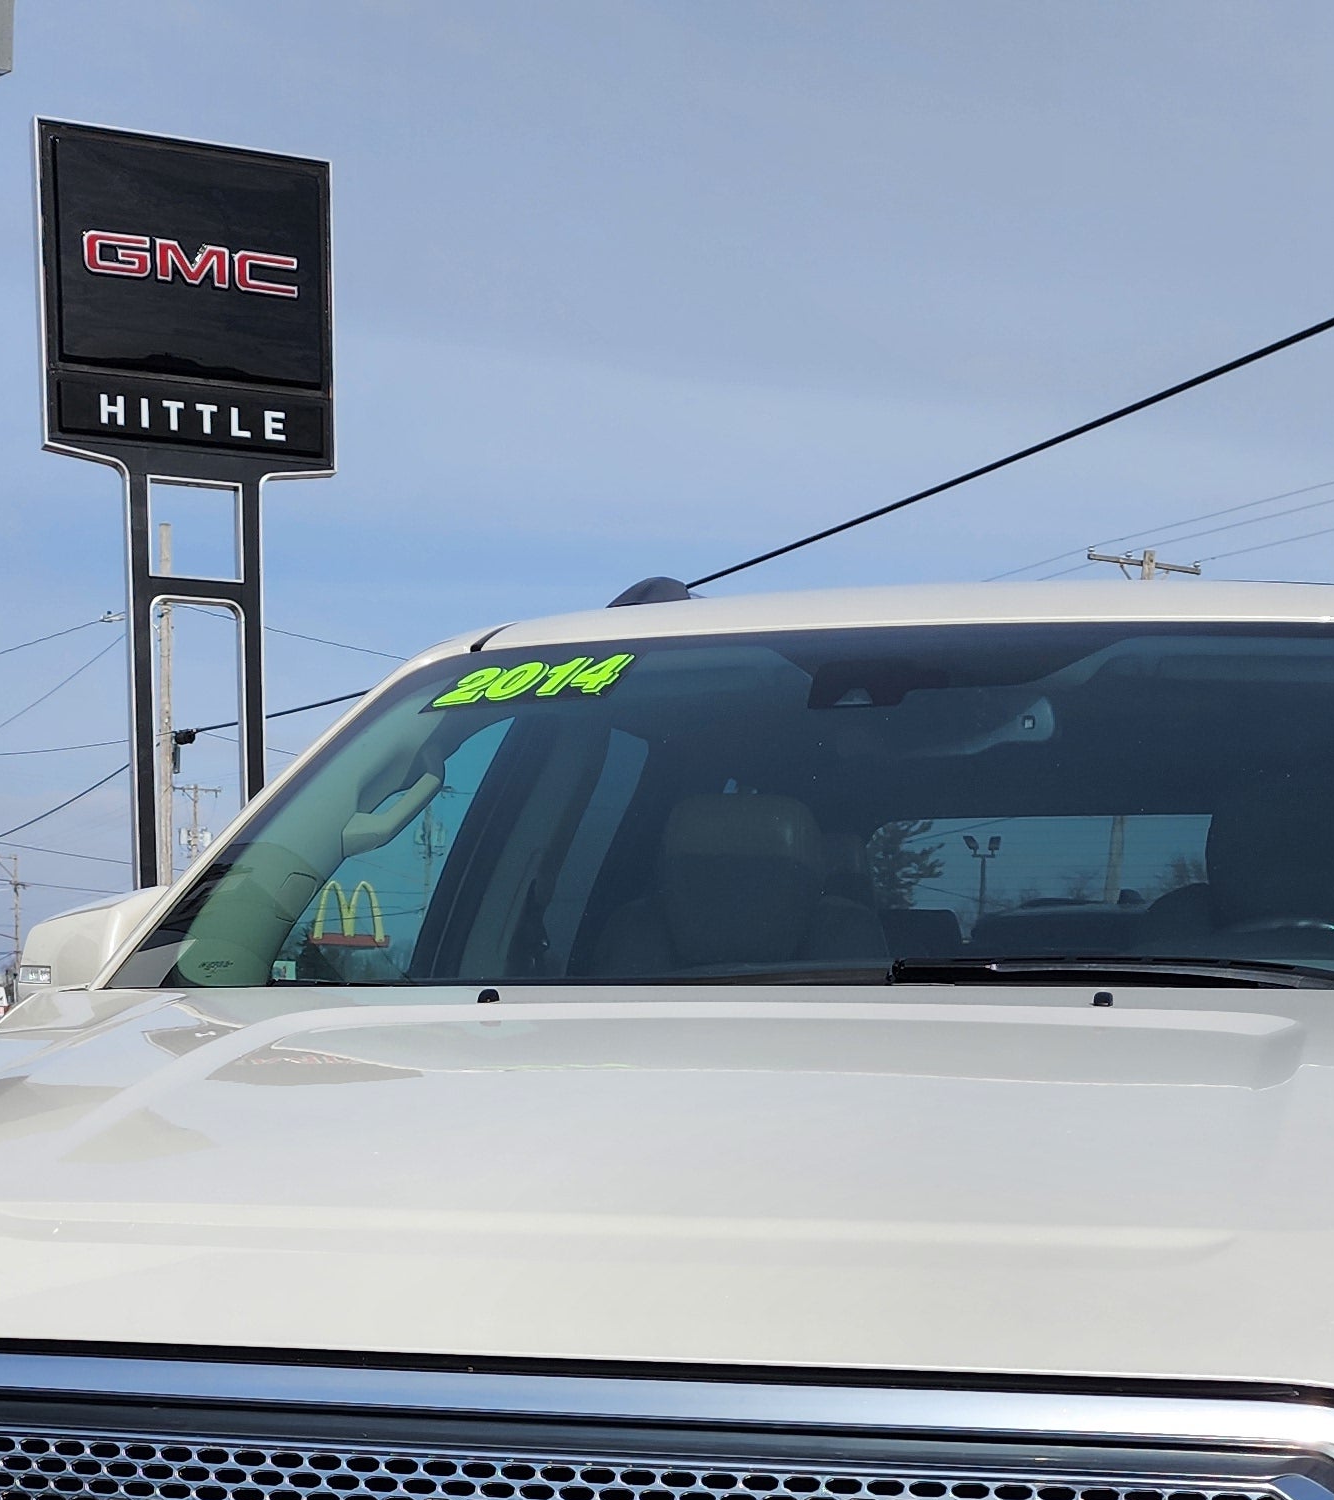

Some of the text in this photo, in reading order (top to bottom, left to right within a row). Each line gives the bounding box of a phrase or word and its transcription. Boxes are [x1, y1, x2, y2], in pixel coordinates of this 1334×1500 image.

[82, 229, 298, 298] GMC
[99, 393, 287, 441] HITTLE
[431, 653, 635, 708] 2014
